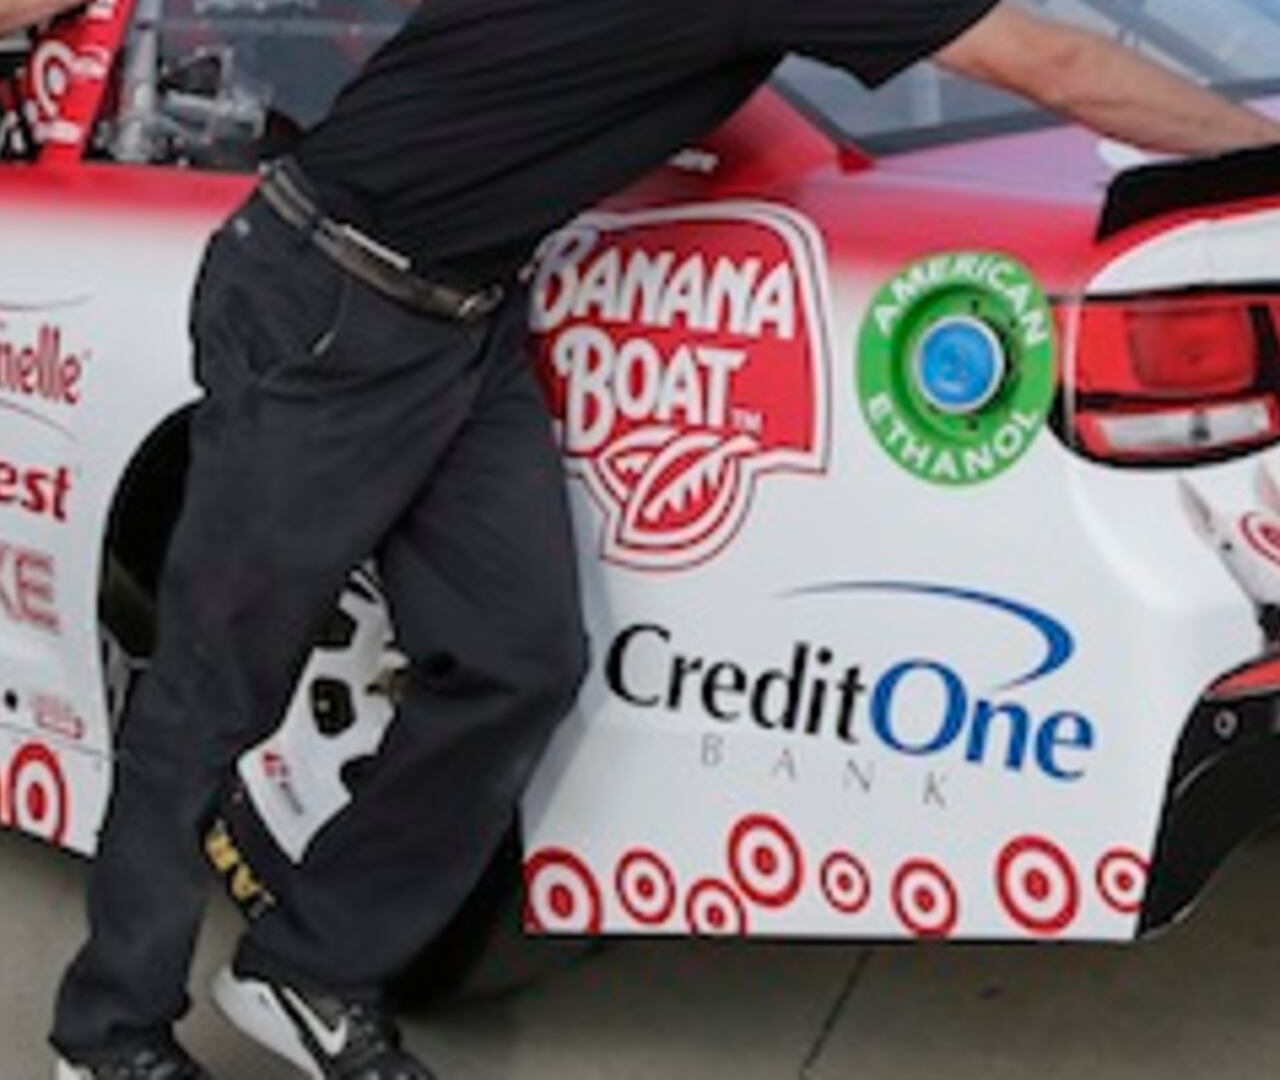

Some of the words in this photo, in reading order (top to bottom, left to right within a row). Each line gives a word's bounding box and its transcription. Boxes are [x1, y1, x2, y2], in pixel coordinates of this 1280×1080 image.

[528, 227, 797, 341] BANANA
[873, 253, 1049, 346] AMERICAN
[554, 325, 747, 452] BOAT
[868, 392, 1039, 479] ETHANOL
[700, 735, 948, 810] BANK
